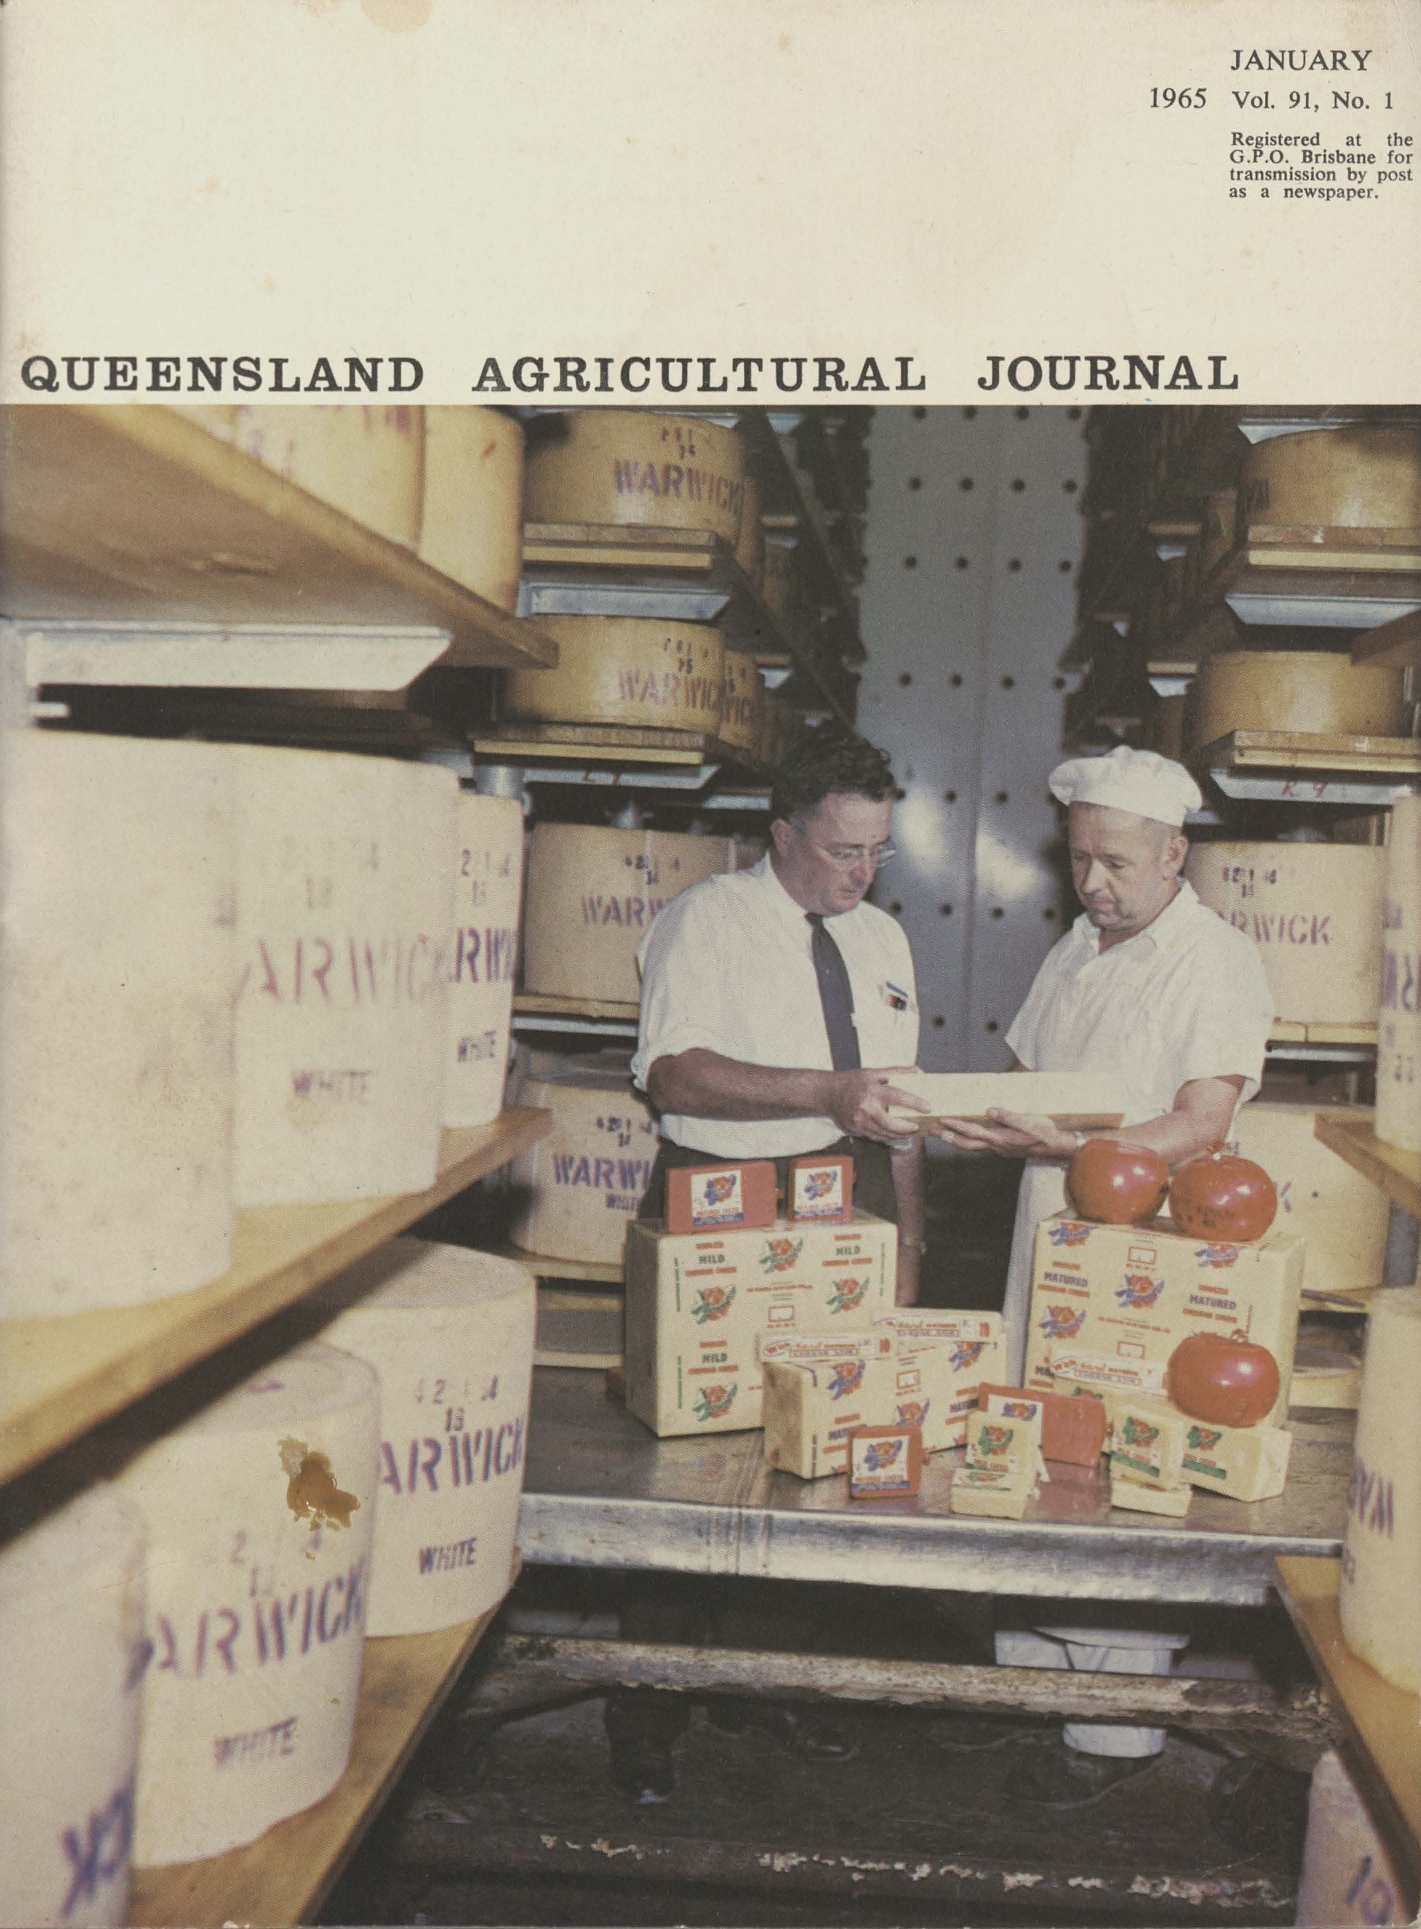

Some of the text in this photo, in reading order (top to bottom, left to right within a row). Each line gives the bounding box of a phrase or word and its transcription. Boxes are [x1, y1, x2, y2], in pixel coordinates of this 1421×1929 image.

[1231, 49, 1373, 71] JANUARY
[1150, 87, 1393, 113] 1965 Vol. 91, No. 1
[1231, 131, 1413, 149] Registered at the
[1229, 149, 1414, 165] G.P.O. Brisbane for
[1229, 166, 1414, 184] transmission by post
[1228, 187, 1379, 202] as a newspaper.
[21, 354, 1239, 393] QUEENSLAND AGRICULTURAL JOURNAL
[1217, 908, 1331, 945] RWICK
[417, 1536, 477, 1575] WHITE
